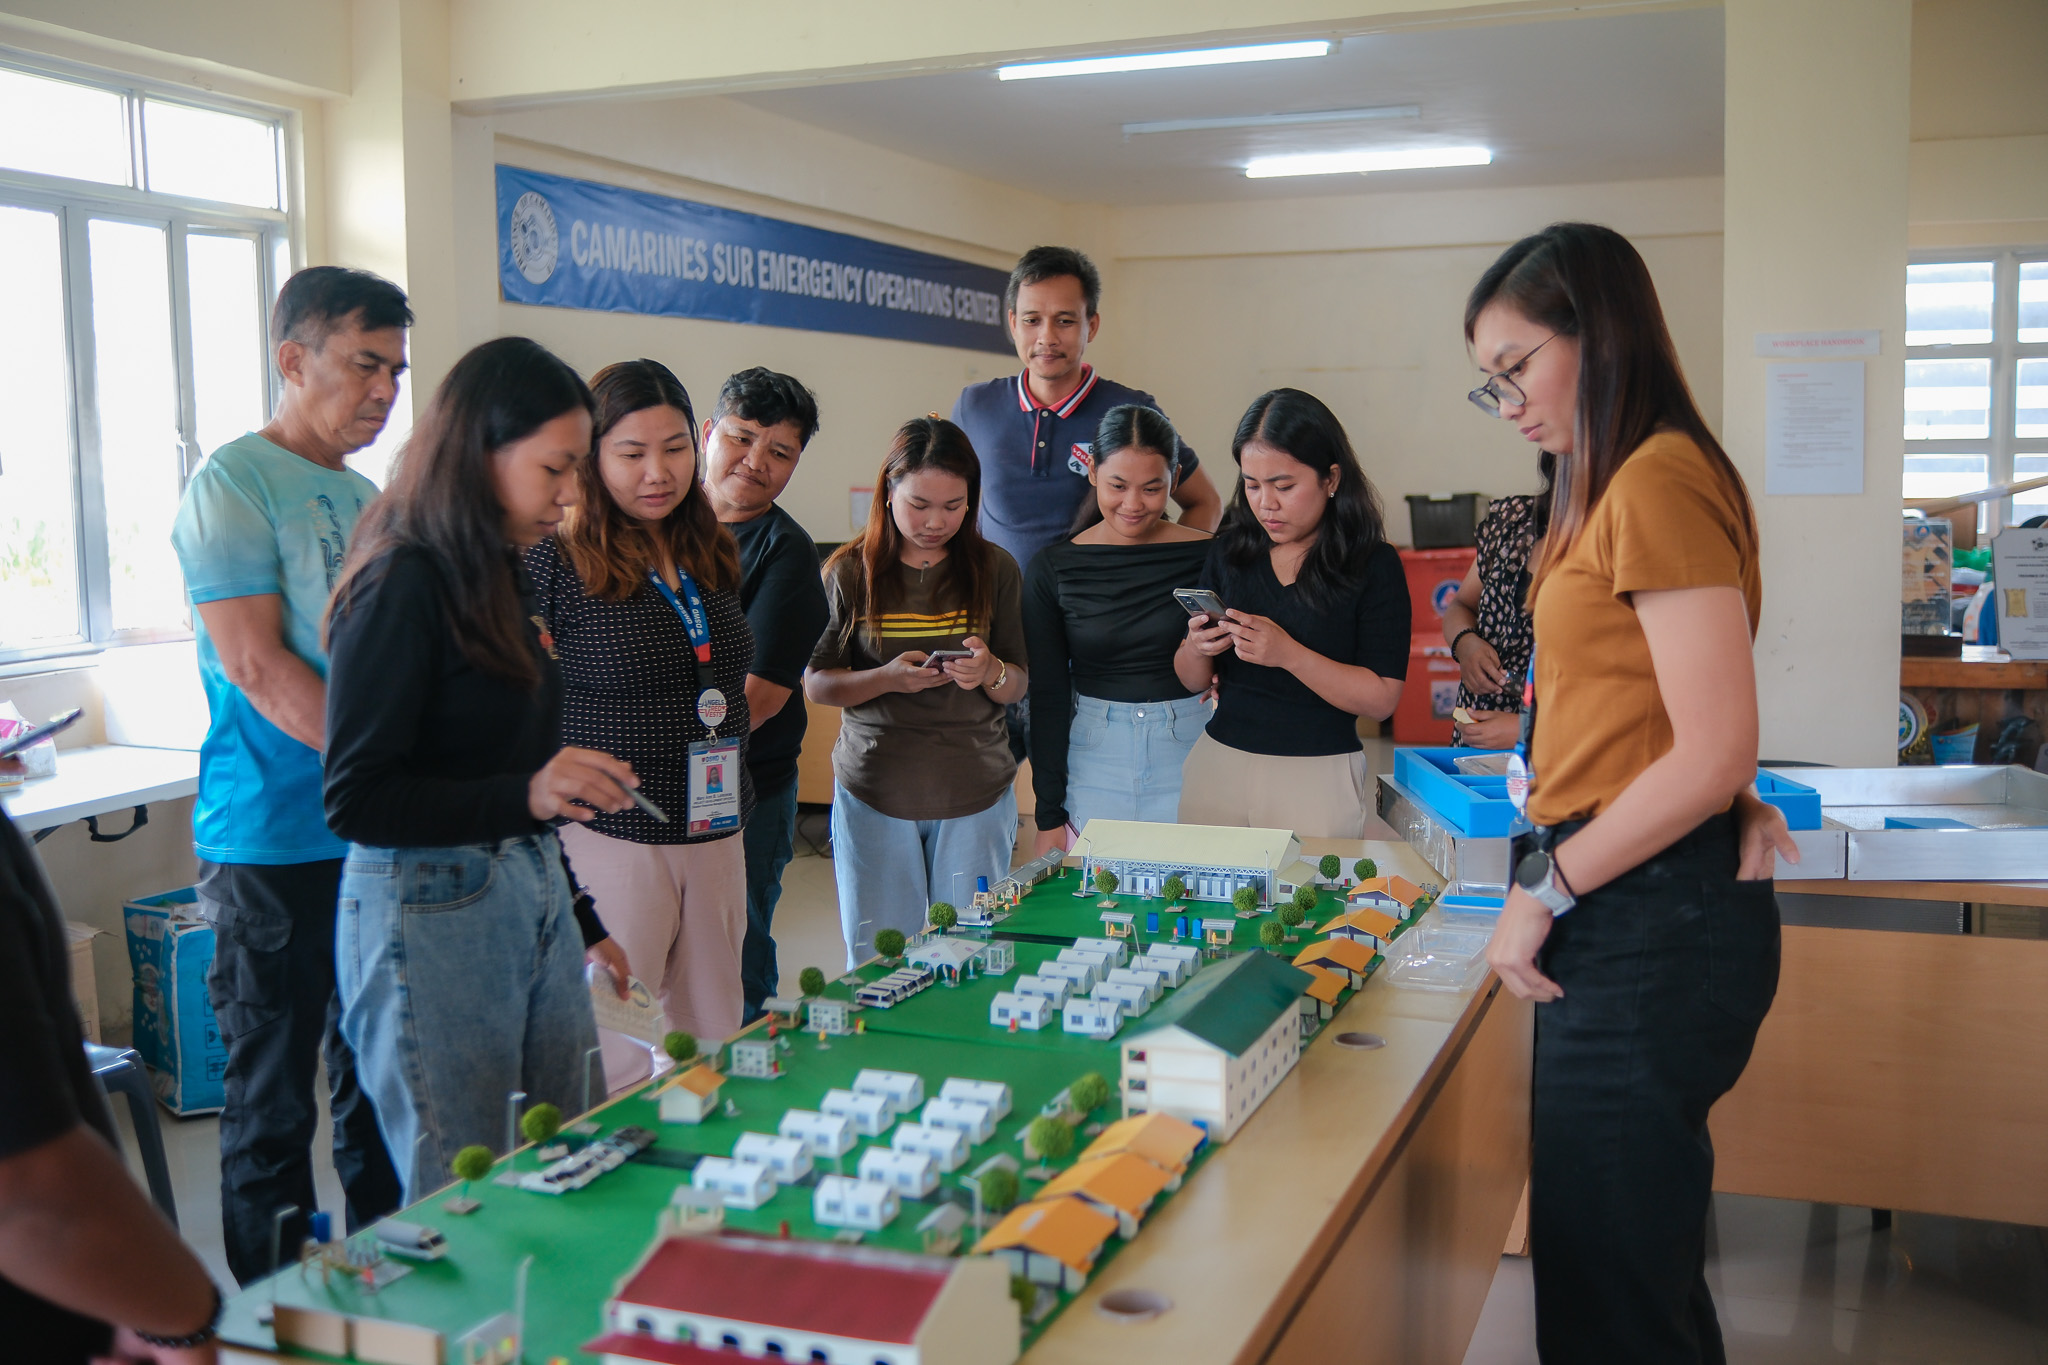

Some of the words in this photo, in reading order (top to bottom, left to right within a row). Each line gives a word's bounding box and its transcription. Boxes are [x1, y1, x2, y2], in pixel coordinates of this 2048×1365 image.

[571, 219, 708, 282] CAMARINES
[712, 242, 755, 288] SUR
[757, 249, 864, 303] EMERGENCY
[865, 269, 952, 317] OPERATIONS
[953, 287, 1001, 326] CENTER
[1772, 340, 1819, 348] WORKPLACE
[1821, 337, 1865, 346] HANDBOOK
[678, 605, 693, 625] DSWD
[692, 608, 703, 629] DSWD
[701, 699, 725, 708] ANGELS
[705, 709, 723, 717] VESTS
